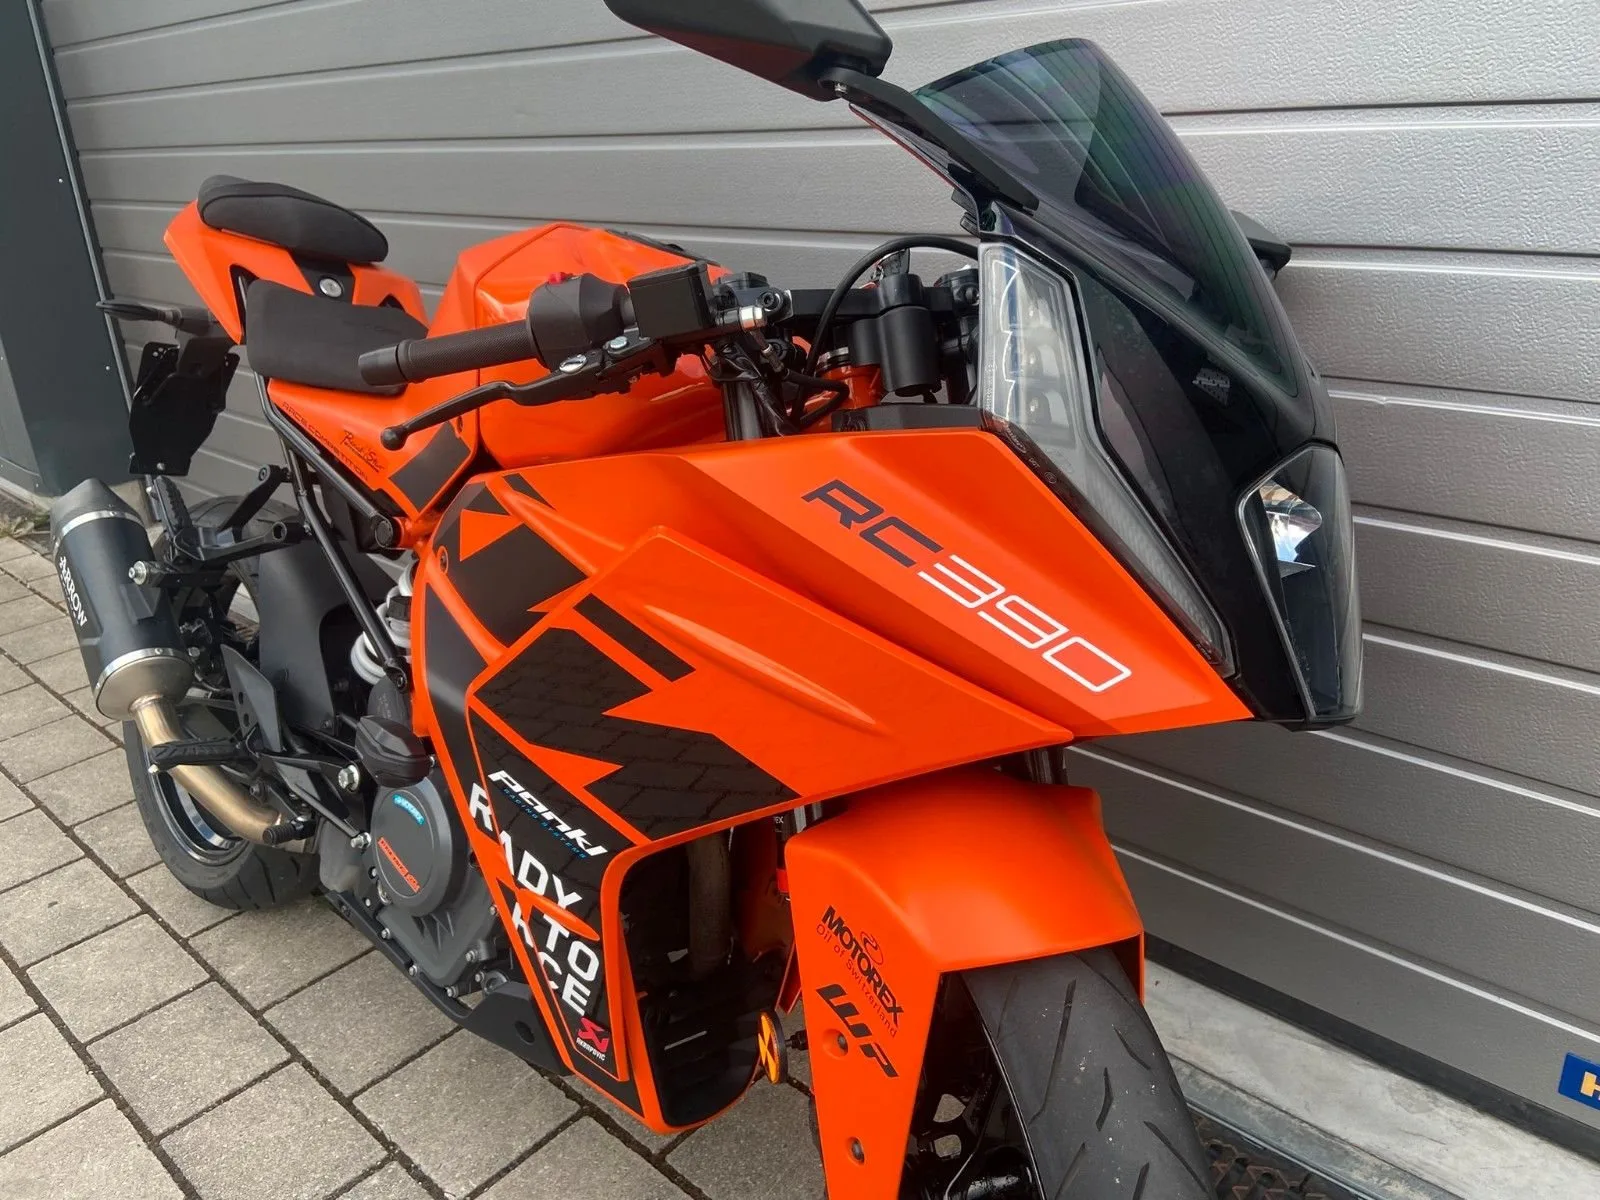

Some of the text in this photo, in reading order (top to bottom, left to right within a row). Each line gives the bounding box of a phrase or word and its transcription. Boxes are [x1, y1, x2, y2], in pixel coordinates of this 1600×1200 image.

[59, 556, 88, 627] ARROW
[469, 782, 583, 910] RADY
[502, 787, 539, 819] RACING
[816, 923, 898, 1038] Oil of Switzerland
[821, 904, 904, 1027] MOTOREX
